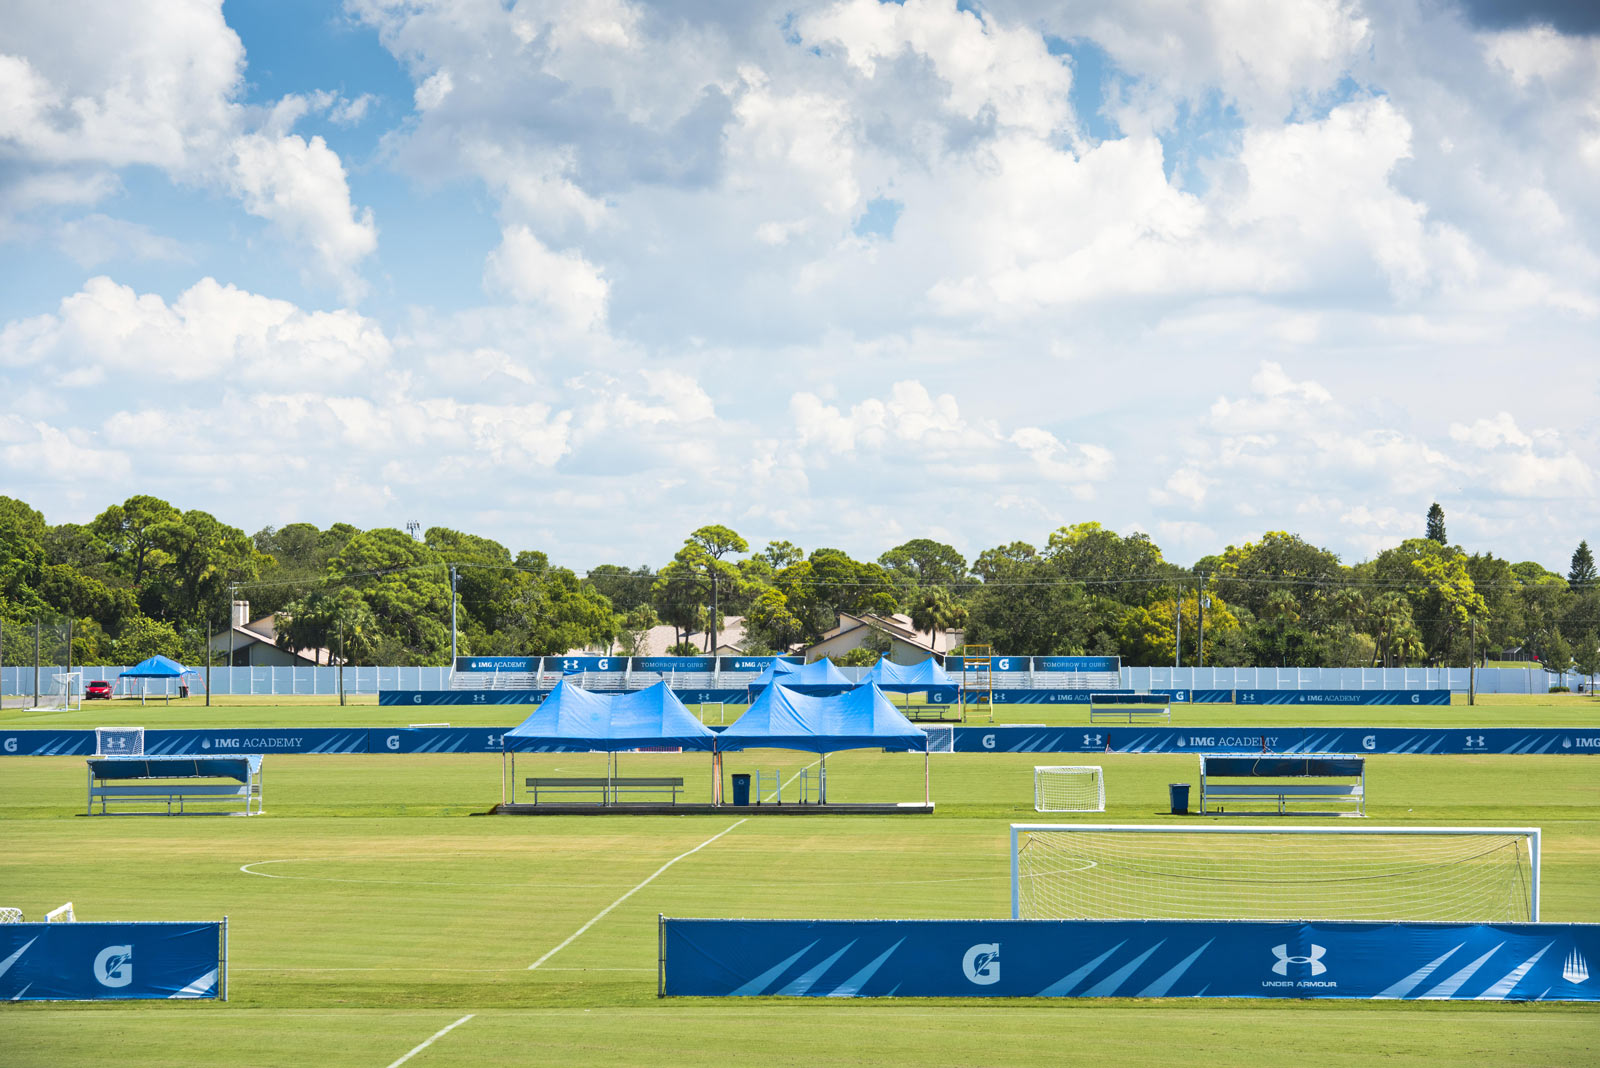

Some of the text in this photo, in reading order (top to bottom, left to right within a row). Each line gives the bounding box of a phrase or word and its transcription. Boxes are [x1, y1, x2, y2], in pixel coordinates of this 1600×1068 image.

[214, 738, 303, 748] IMG ACADEMY
[1189, 737, 1279, 747] IMG ACADEMY
[1575, 738, 1600, 748] IMG
[94, 944, 133, 988] G
[963, 942, 1001, 986] G
